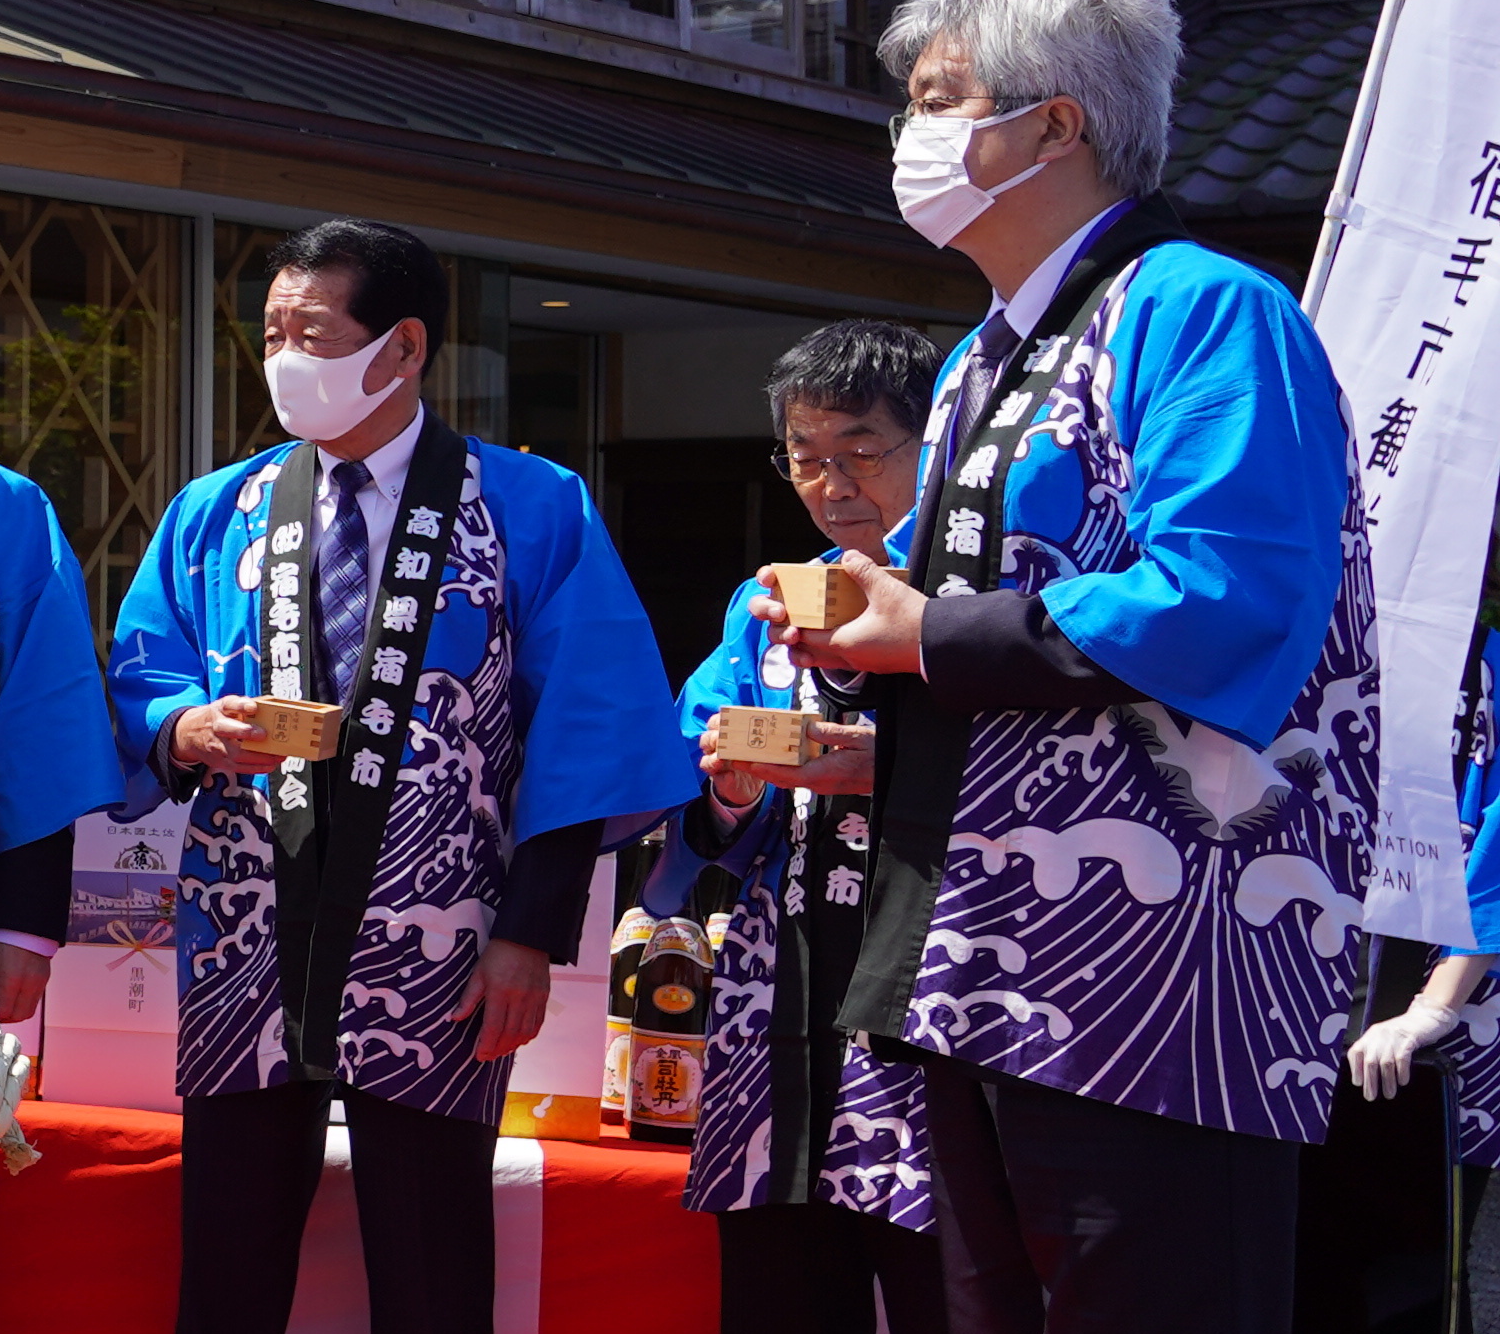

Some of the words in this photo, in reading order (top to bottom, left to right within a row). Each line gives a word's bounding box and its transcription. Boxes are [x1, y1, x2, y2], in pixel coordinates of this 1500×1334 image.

[350, 505, 443, 788] 高知県宿毛市
[652, 1059, 680, 1109] 司牡丹
